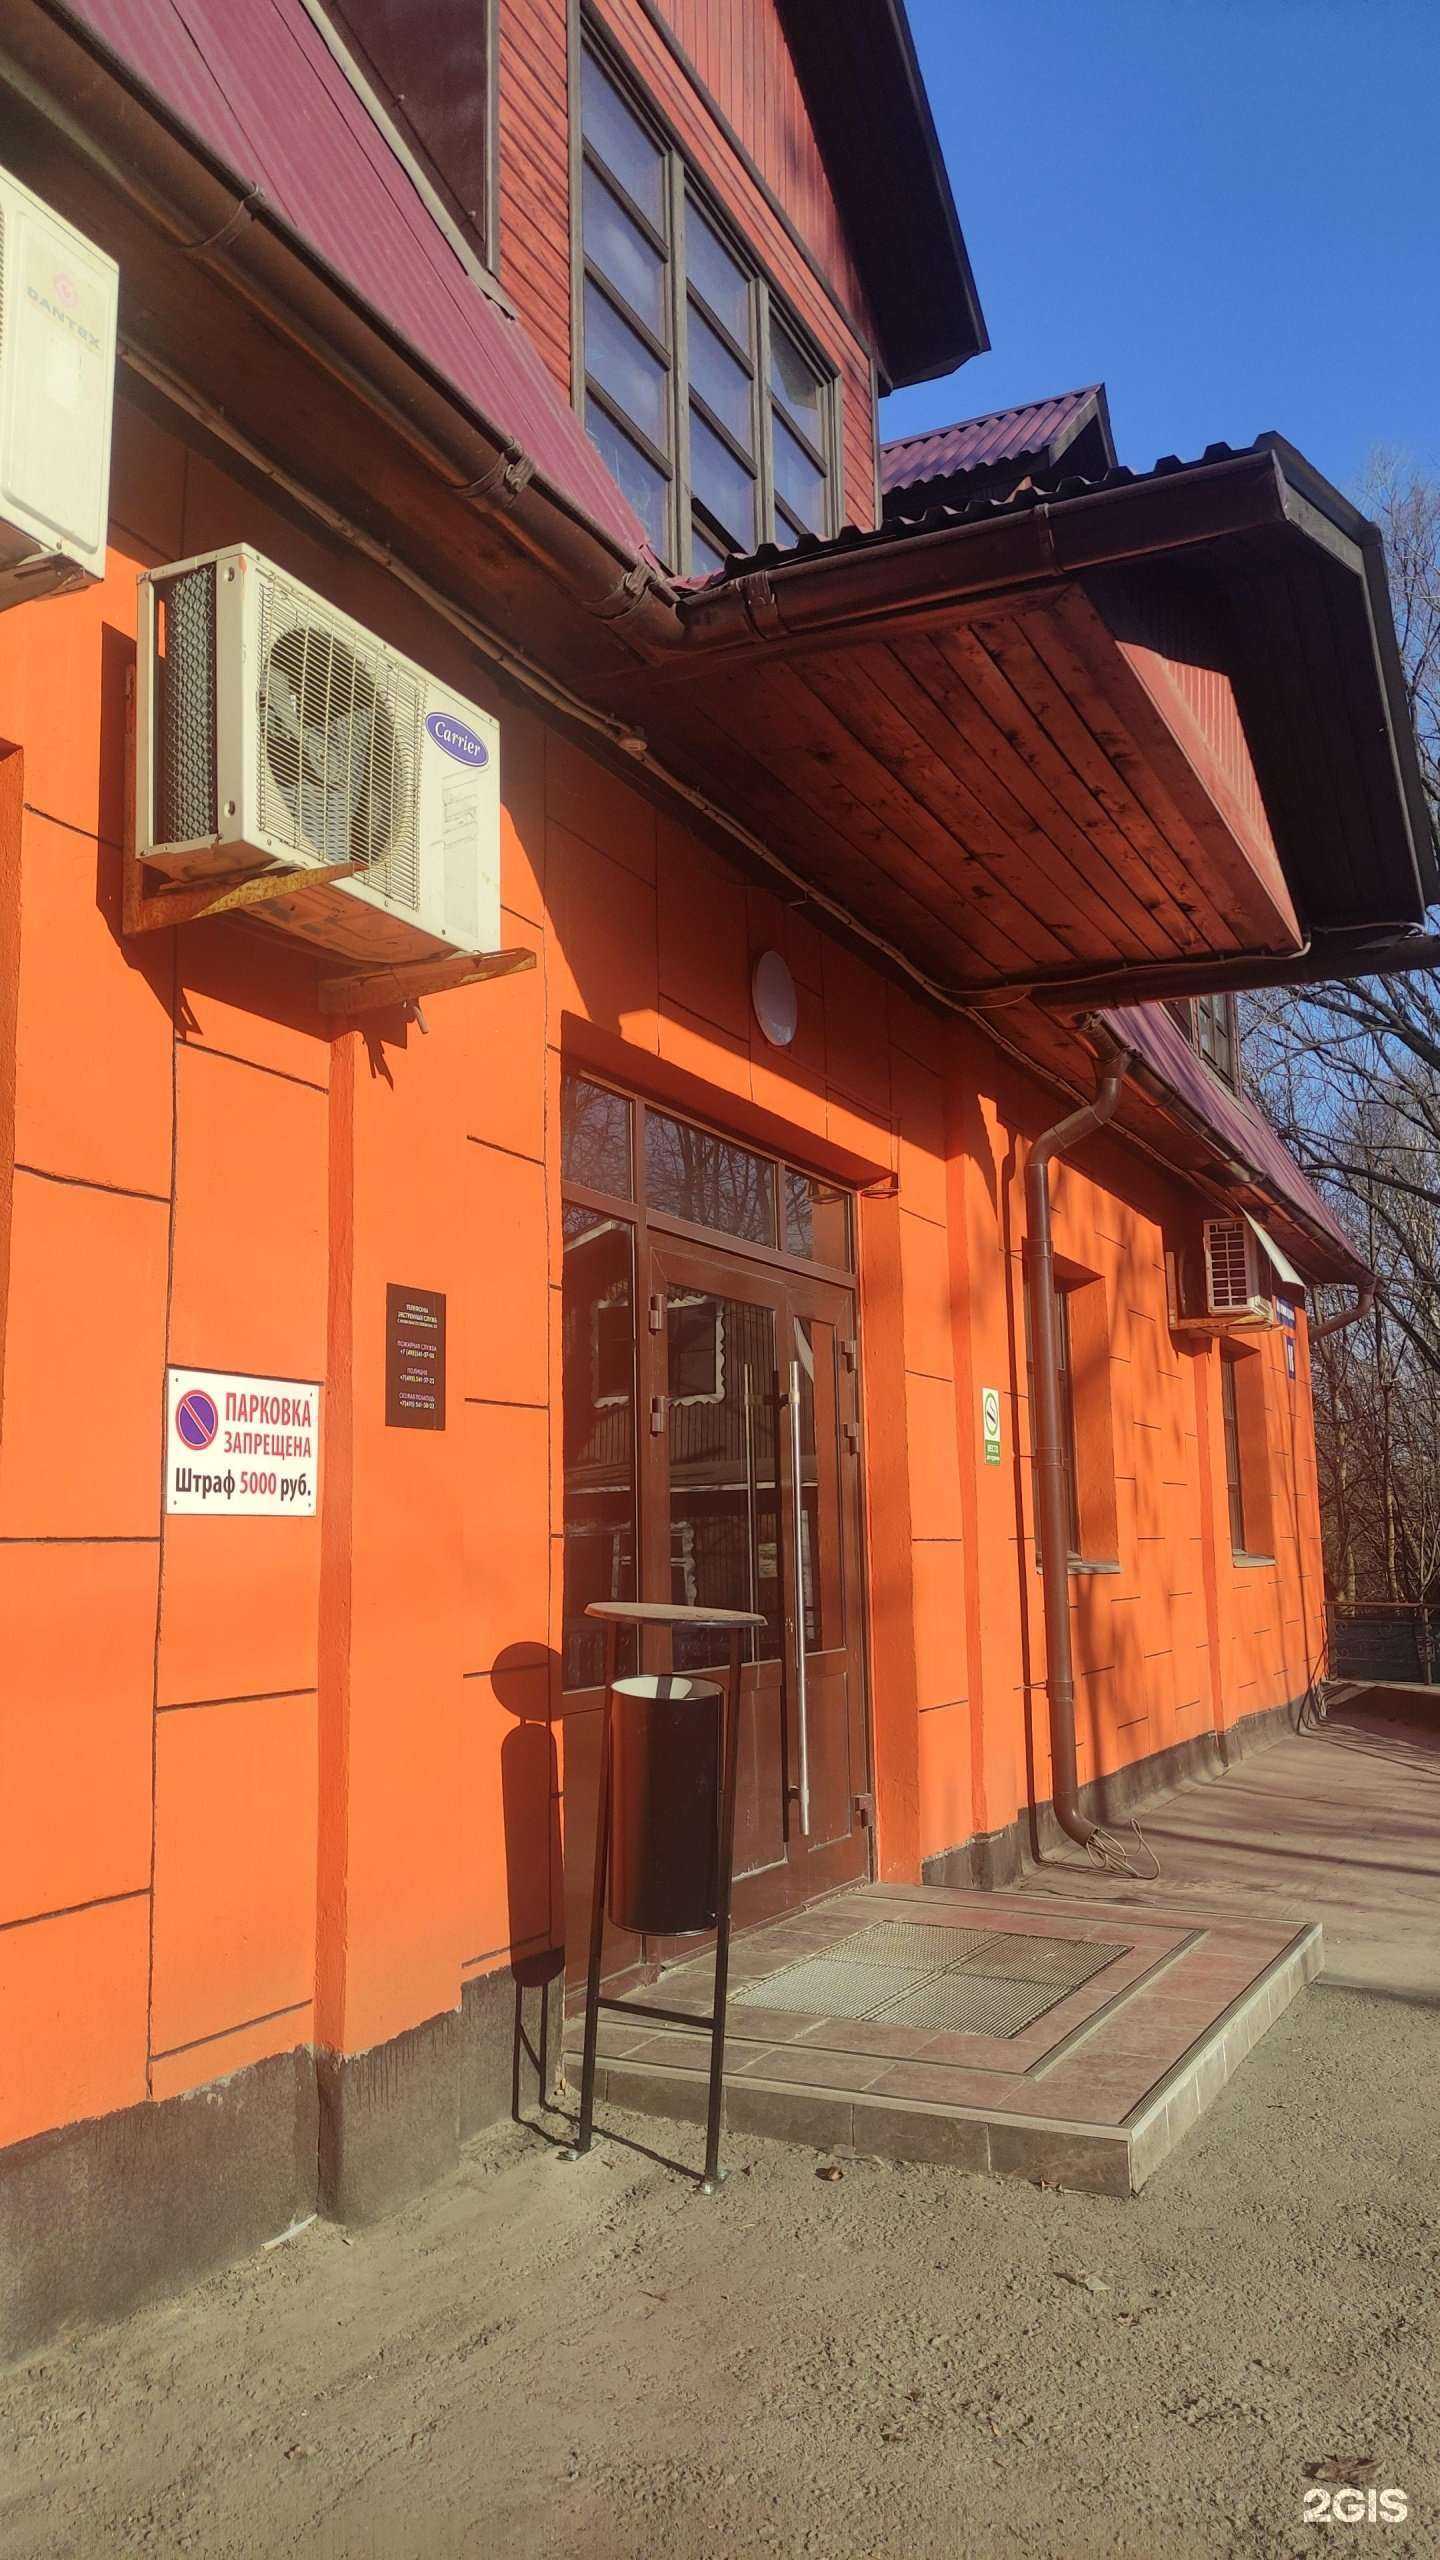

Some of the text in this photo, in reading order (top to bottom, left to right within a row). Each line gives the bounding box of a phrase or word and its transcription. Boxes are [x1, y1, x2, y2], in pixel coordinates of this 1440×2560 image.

[435, 721, 481, 756] Carrier
[225, 1392, 312, 1428] ПАРКОВКА
[224, 1431, 311, 1460] ЗАПРЕЩЕНА
[175, 1467, 312, 1502] Штраф 5000 руб.
